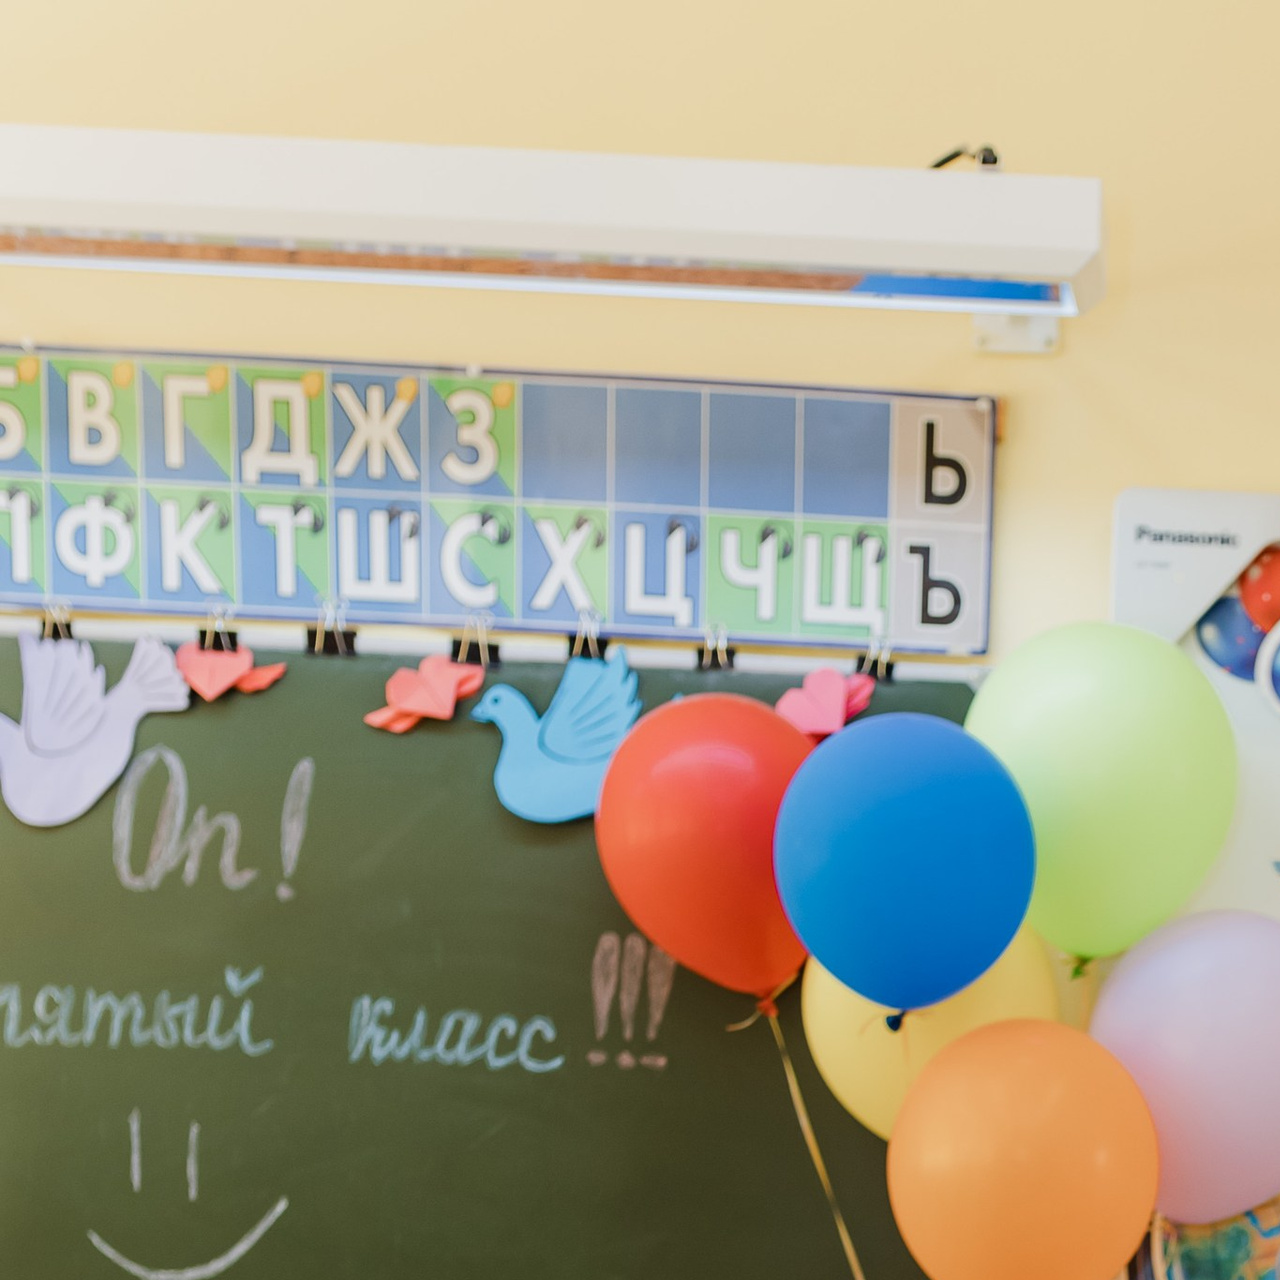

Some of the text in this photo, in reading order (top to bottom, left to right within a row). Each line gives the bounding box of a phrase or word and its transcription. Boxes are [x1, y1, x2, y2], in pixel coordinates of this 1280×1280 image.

[66, 369, 123, 467] В
[162, 373, 219, 470] Г
[240, 379, 320, 486] Д
[332, 384, 421, 483] Ж
[54, 496, 136, 588] Ф
[159, 500, 225, 594] К
[255, 504, 318, 598] Т
[336, 508, 421, 602] Ш
[530, 518, 598, 612] Х
[624, 523, 694, 628] Ц
[719, 528, 777, 622] Ч
[802, 532, 886, 636] Щ
